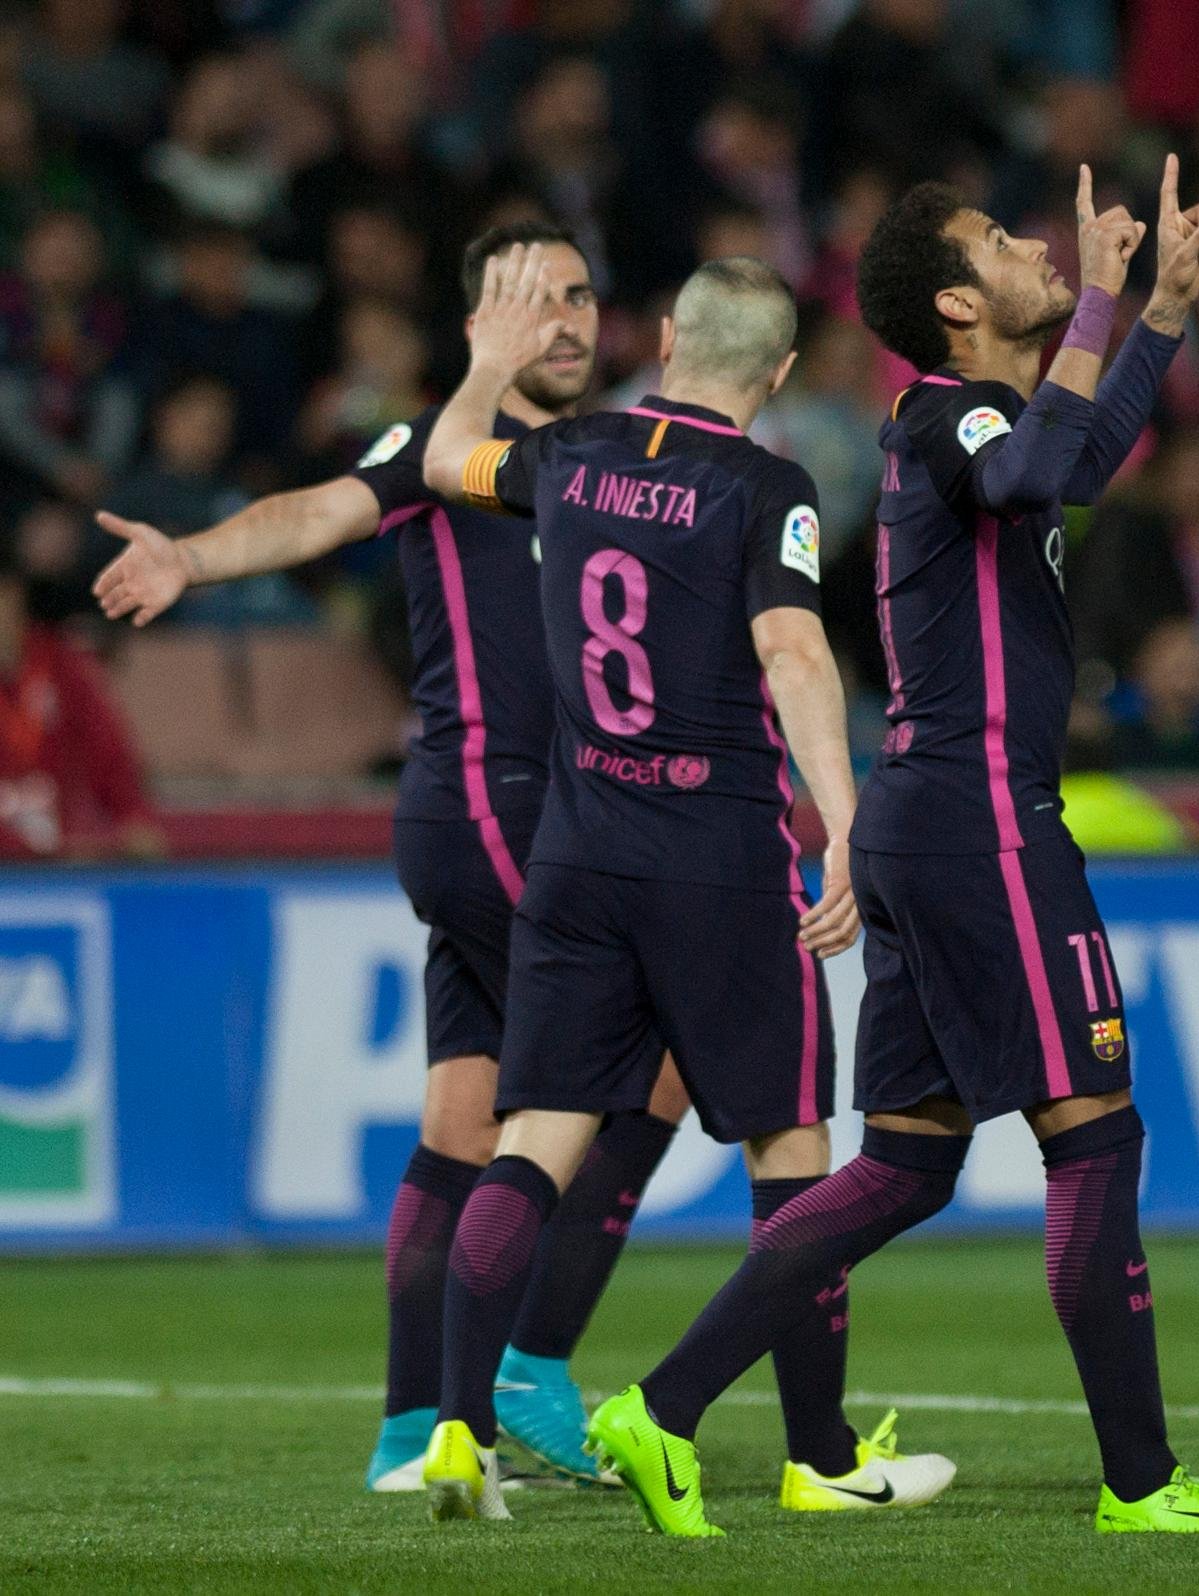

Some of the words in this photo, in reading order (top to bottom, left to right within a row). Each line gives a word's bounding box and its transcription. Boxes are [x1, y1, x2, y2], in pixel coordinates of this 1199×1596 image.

[562, 464, 588, 506] A.
[594, 471, 697, 528] INIESTA
[581, 549, 655, 736] 8
[576, 744, 666, 785] unicef
[1067, 932, 1118, 1012] 11
